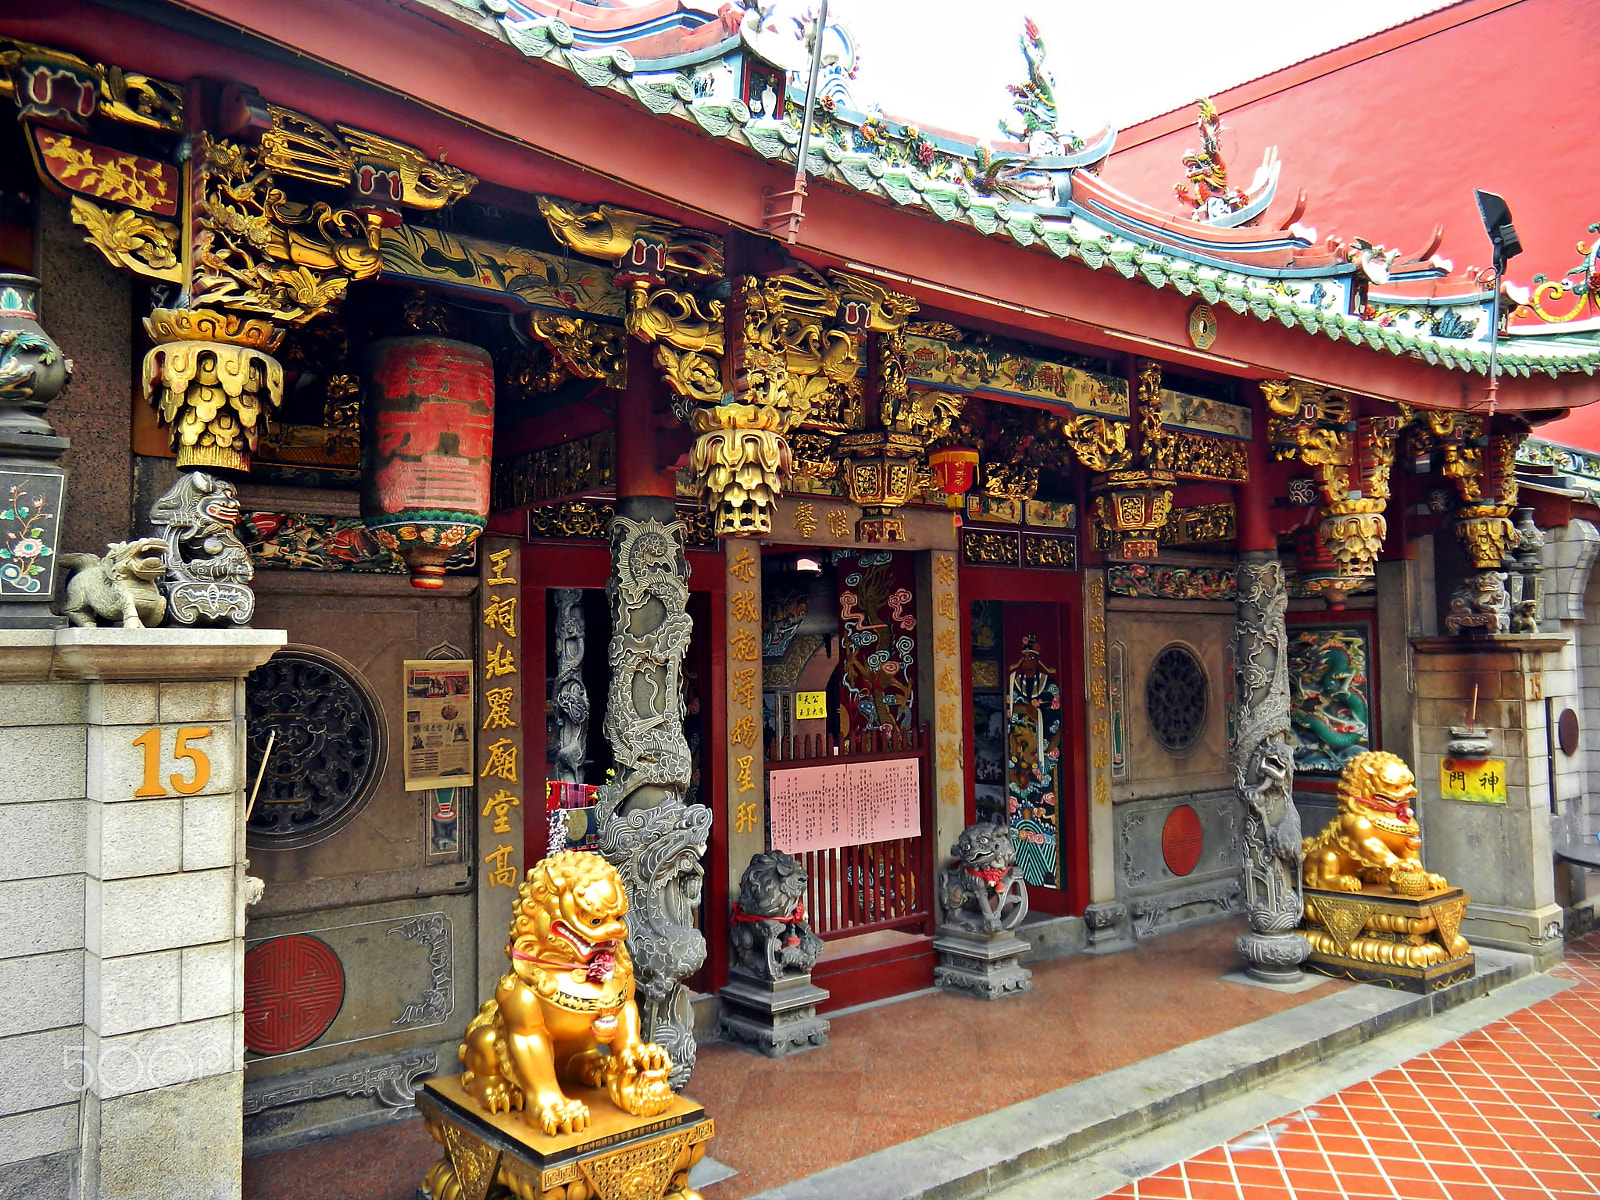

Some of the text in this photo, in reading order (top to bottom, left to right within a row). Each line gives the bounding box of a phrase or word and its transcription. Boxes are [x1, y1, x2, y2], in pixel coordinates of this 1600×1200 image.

[804, 695, 820, 704] 天公
[1530, 674, 1542, 701] 15
[480, 548, 521, 889] 王祠壯麗廟堂高
[132, 727, 212, 797] 15
[1449, 771, 1500, 795] 門神
